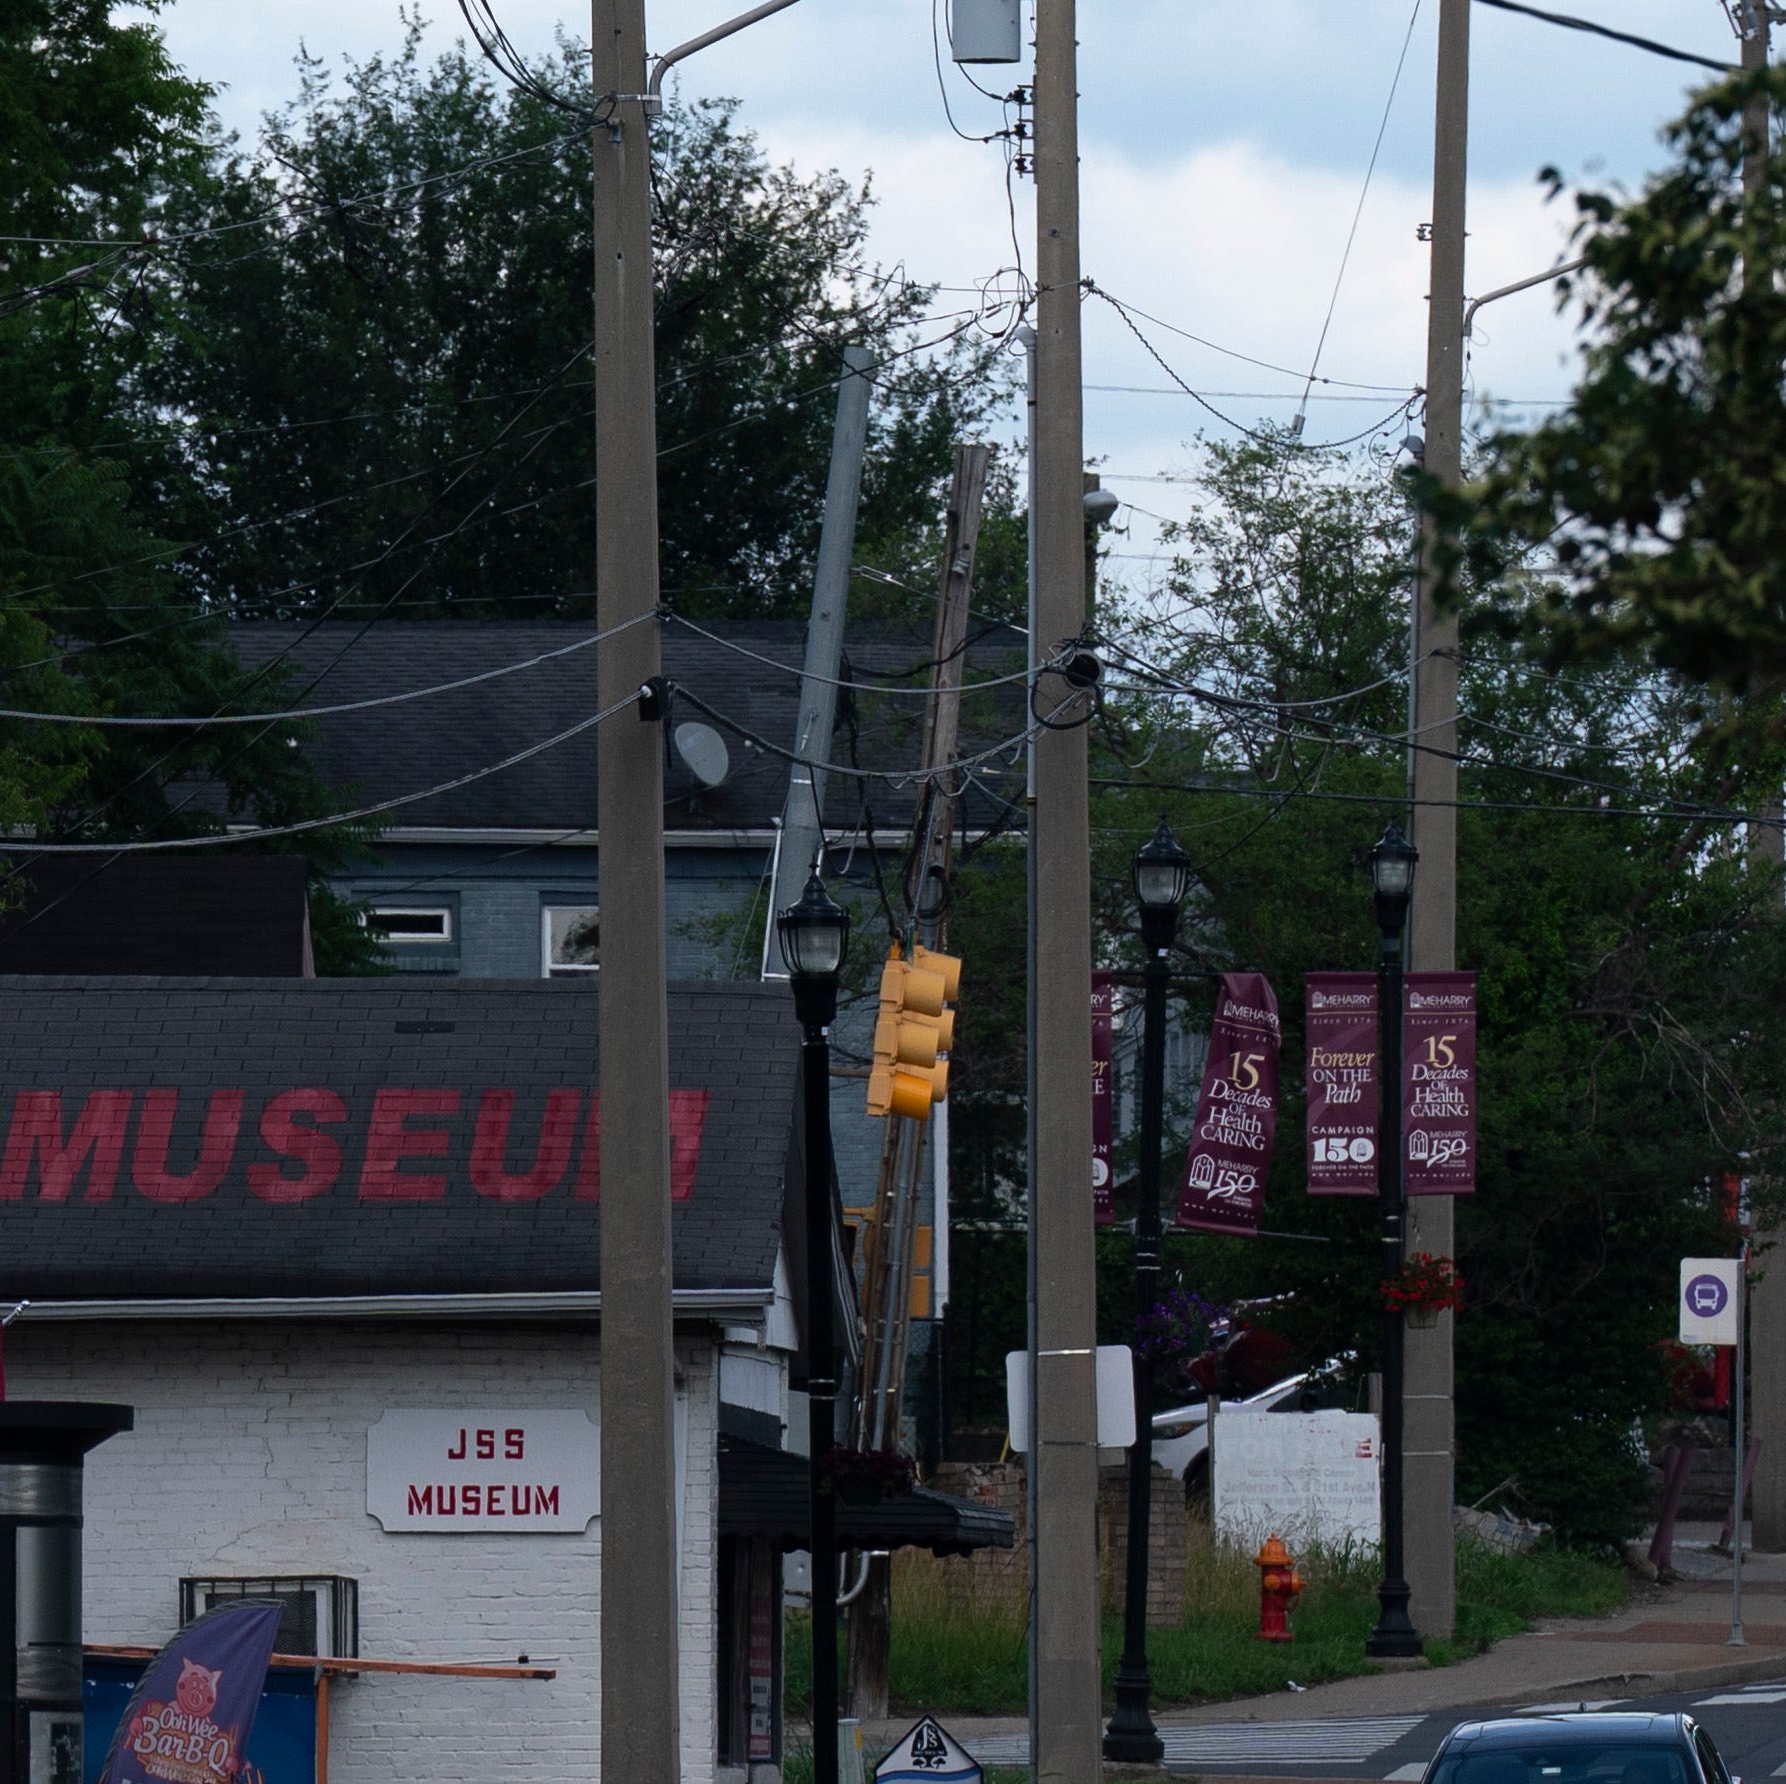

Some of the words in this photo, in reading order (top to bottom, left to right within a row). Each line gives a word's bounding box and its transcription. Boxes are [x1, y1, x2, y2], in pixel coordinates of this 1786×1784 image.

[1323, 993, 1372, 1005] MEHARRY
[1420, 994, 1470, 1005] MEHARRY
[1231, 1005, 1279, 1028] MEHARRY
[1310, 1047, 1375, 1068] Forever
[1423, 1035, 1457, 1069] 15
[1227, 1051, 1265, 1091] 15
[1313, 1069, 1337, 1083] ON
[1340, 1069, 1373, 1083] THE
[1411, 1064, 1469, 1081] Decades
[1208, 1079, 1273, 1109] Decades
[1324, 1082, 1362, 1104] Path
[1415, 1086, 1465, 1104] Health
[1431, 1080, 1447, 1091] OF
[1229, 1102, 1246, 1115] OF
[1410, 1104, 1470, 1117] CARING
[1209, 1106, 1263, 1135] Health
[1312, 1126, 1375, 1135] CAMPAIGN
[1201, 1124, 1266, 1152] CARING
[1312, 1137, 1375, 1163] 150
[1429, 1138, 1468, 1164] 150
[1212, 1167, 1258, 1199] 150
[447, 1427, 526, 1462] JSS
[407, 1484, 561, 1518] MUSEUM
[133, 1716, 229, 1777] Bar-B-Q
